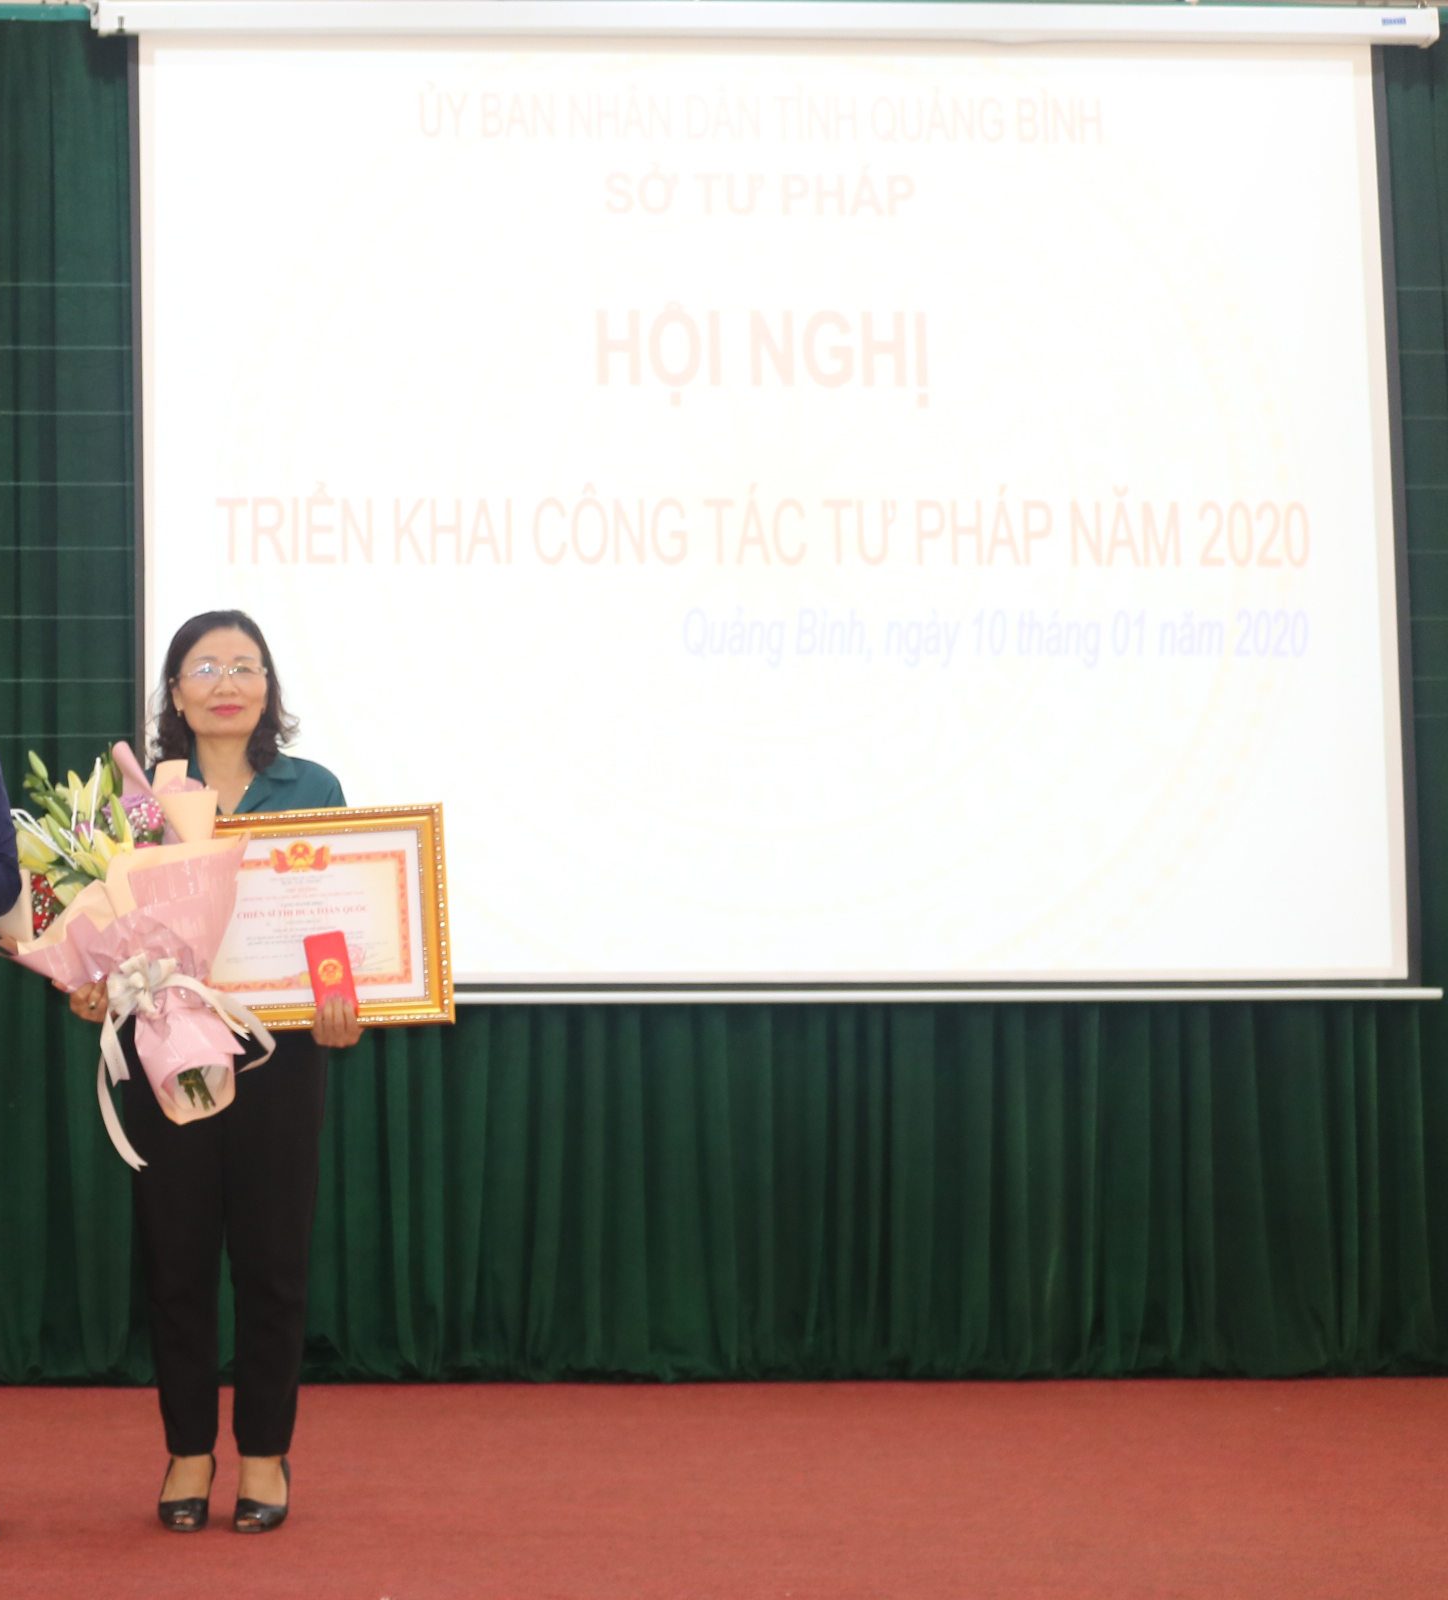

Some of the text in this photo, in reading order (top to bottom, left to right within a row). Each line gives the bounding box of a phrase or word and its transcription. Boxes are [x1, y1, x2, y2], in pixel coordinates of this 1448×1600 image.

[604, 161, 916, 218] SỞ TƯ PHÁP
[595, 300, 930, 410] HỘI NGHỊ
[215, 480, 1311, 569] TRIỂN KHAI CÔNG TÁC TƯ PHÁP NĂM 2020
[682, 606, 1310, 670] Quảng Bình, ngày 10 tháng 01 năm 2020
